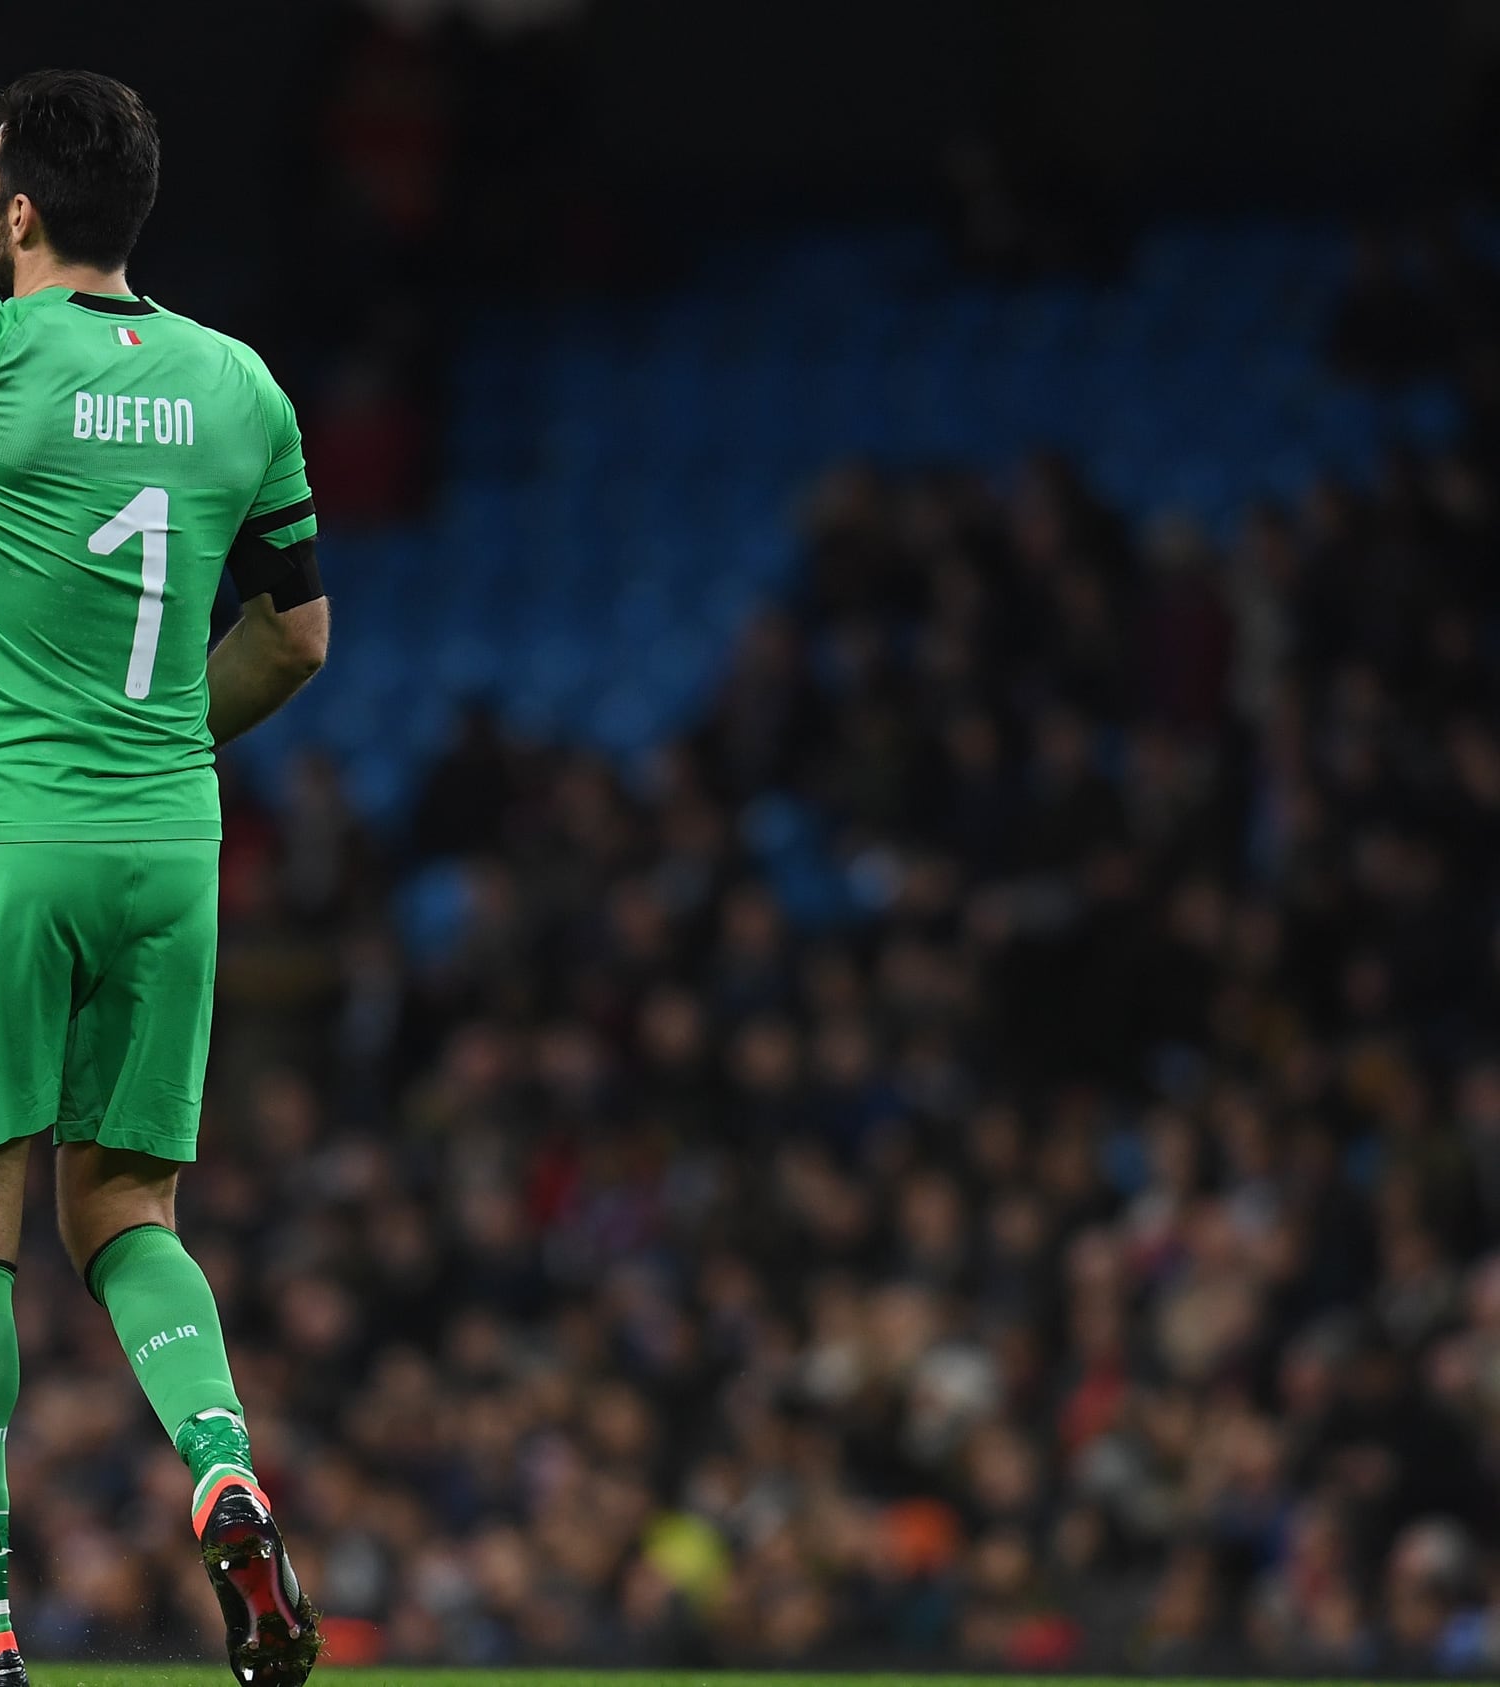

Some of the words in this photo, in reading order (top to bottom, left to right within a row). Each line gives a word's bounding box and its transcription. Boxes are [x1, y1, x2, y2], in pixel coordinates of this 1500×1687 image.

[73, 391, 194, 446] BUFFON
[87, 486, 169, 700] 1
[135, 1324, 199, 1365] ITALIA
